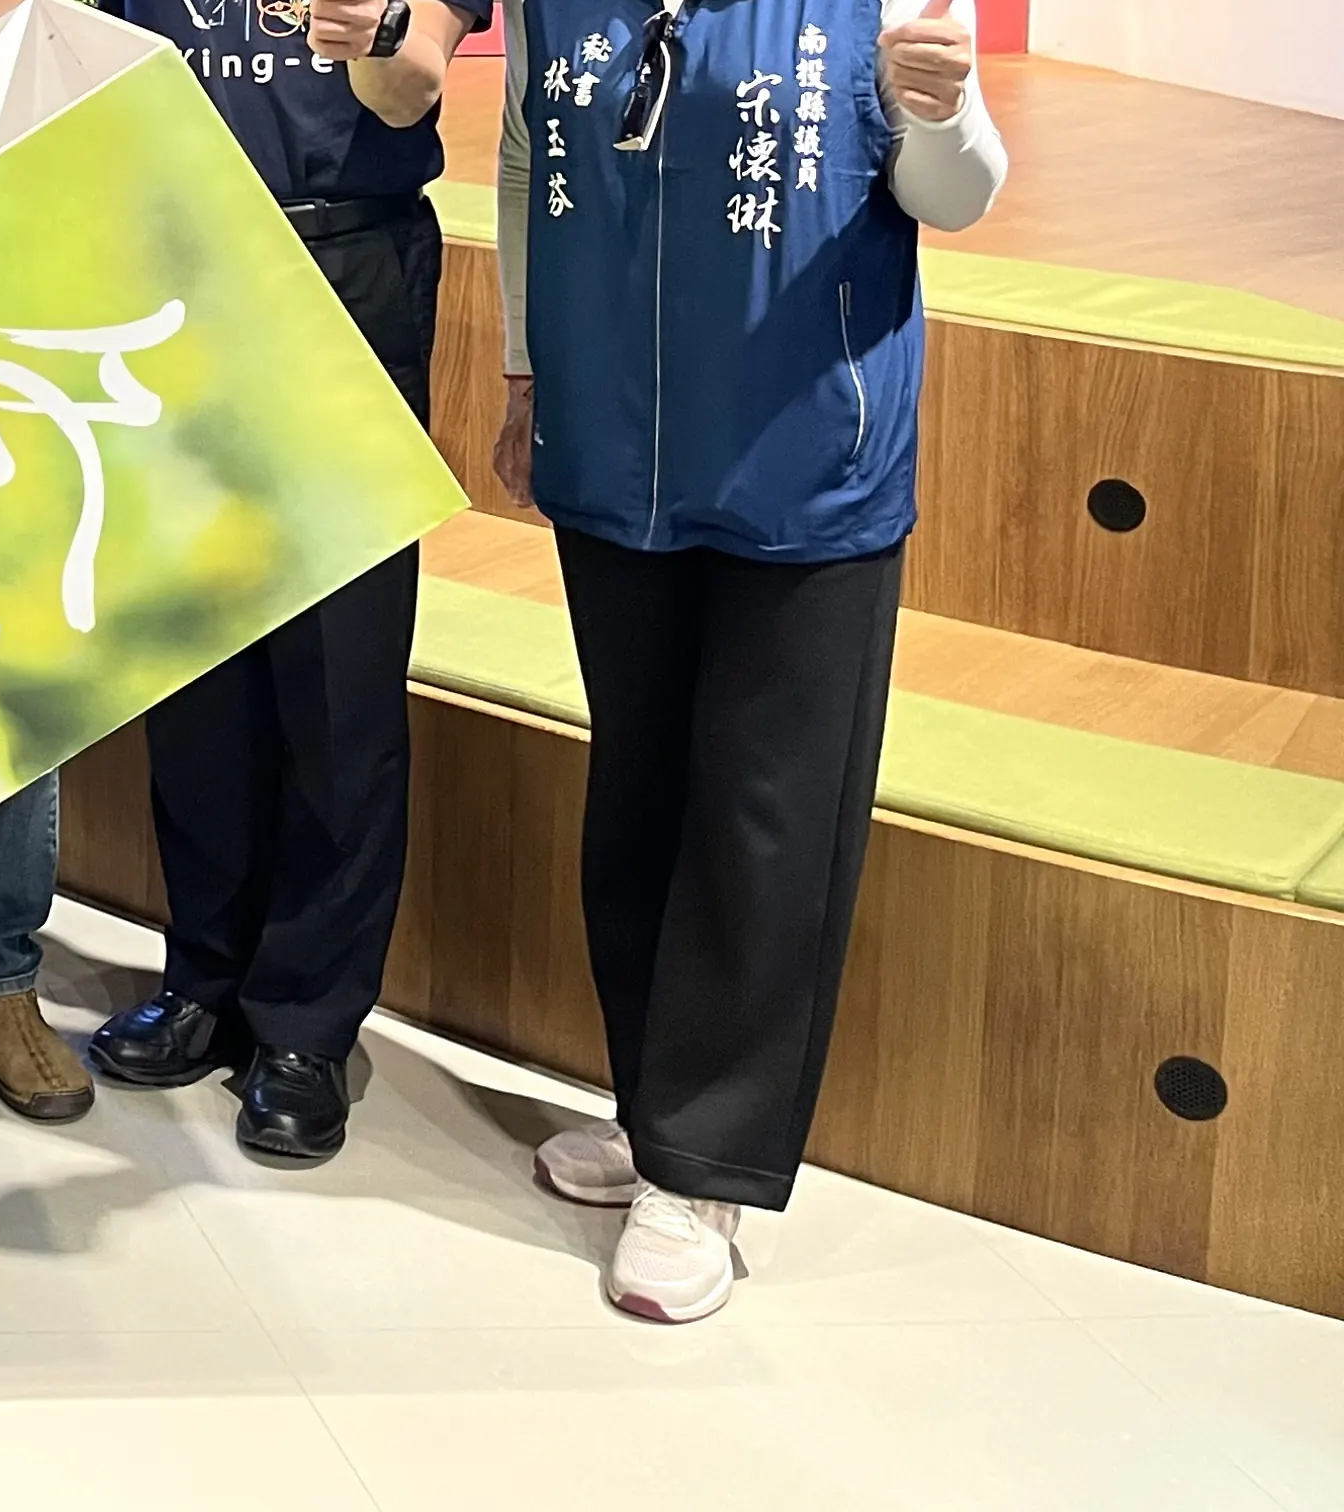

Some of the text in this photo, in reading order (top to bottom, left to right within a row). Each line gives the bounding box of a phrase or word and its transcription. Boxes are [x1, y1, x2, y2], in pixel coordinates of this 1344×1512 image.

[543, 57, 574, 218] 林玉芬
[572, 33, 612, 107] 秘書
[794, 23, 830, 192] 南投縣議員
[727, 70, 782, 250] 宋懷琳
